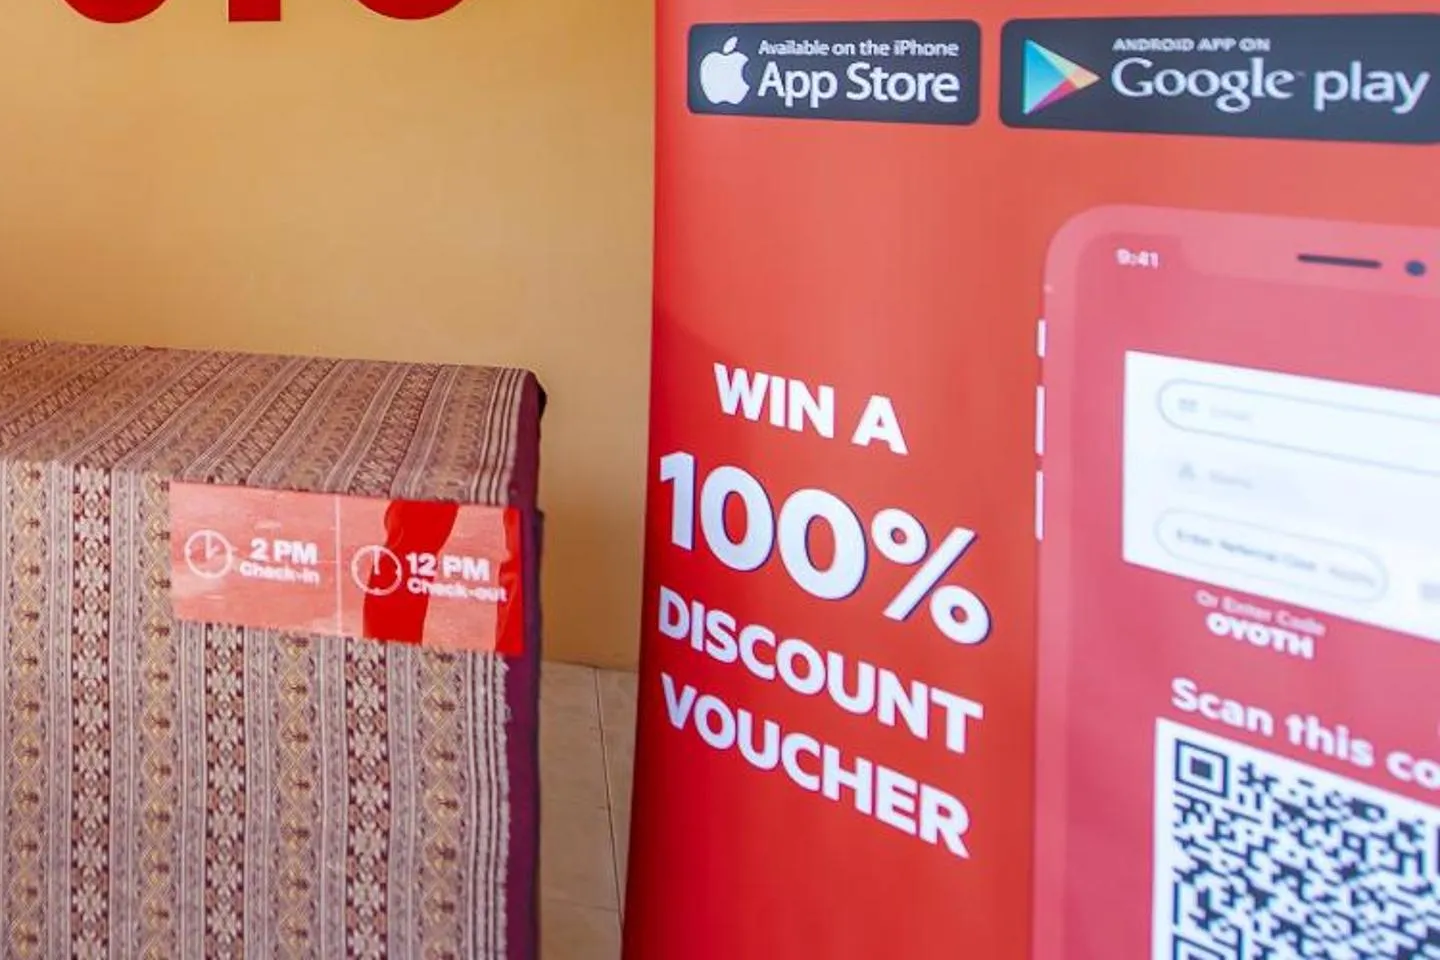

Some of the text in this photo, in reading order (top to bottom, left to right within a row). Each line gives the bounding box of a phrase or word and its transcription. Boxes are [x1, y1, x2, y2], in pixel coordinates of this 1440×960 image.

[758, 40, 959, 57] Available on the iPhone
[1112, 39, 1271, 52] ANDROID APP ON
[757, 61, 960, 108] App Store
[1111, 56, 1432, 115] Google play
[1116, 248, 1160, 268] 9:41
[713, 362, 909, 456] WIN A
[251, 538, 319, 565] 2 PM
[406, 552, 490, 581] 12 PM
[660, 451, 992, 645] 100%
[239, 560, 320, 584] Check-in
[408, 578, 507, 603] Check-out
[659, 585, 984, 754] DISCOUNT
[1171, 677, 1274, 736] Scan
[1285, 714, 1375, 768] this
[661, 672, 971, 859] VOUCHER
